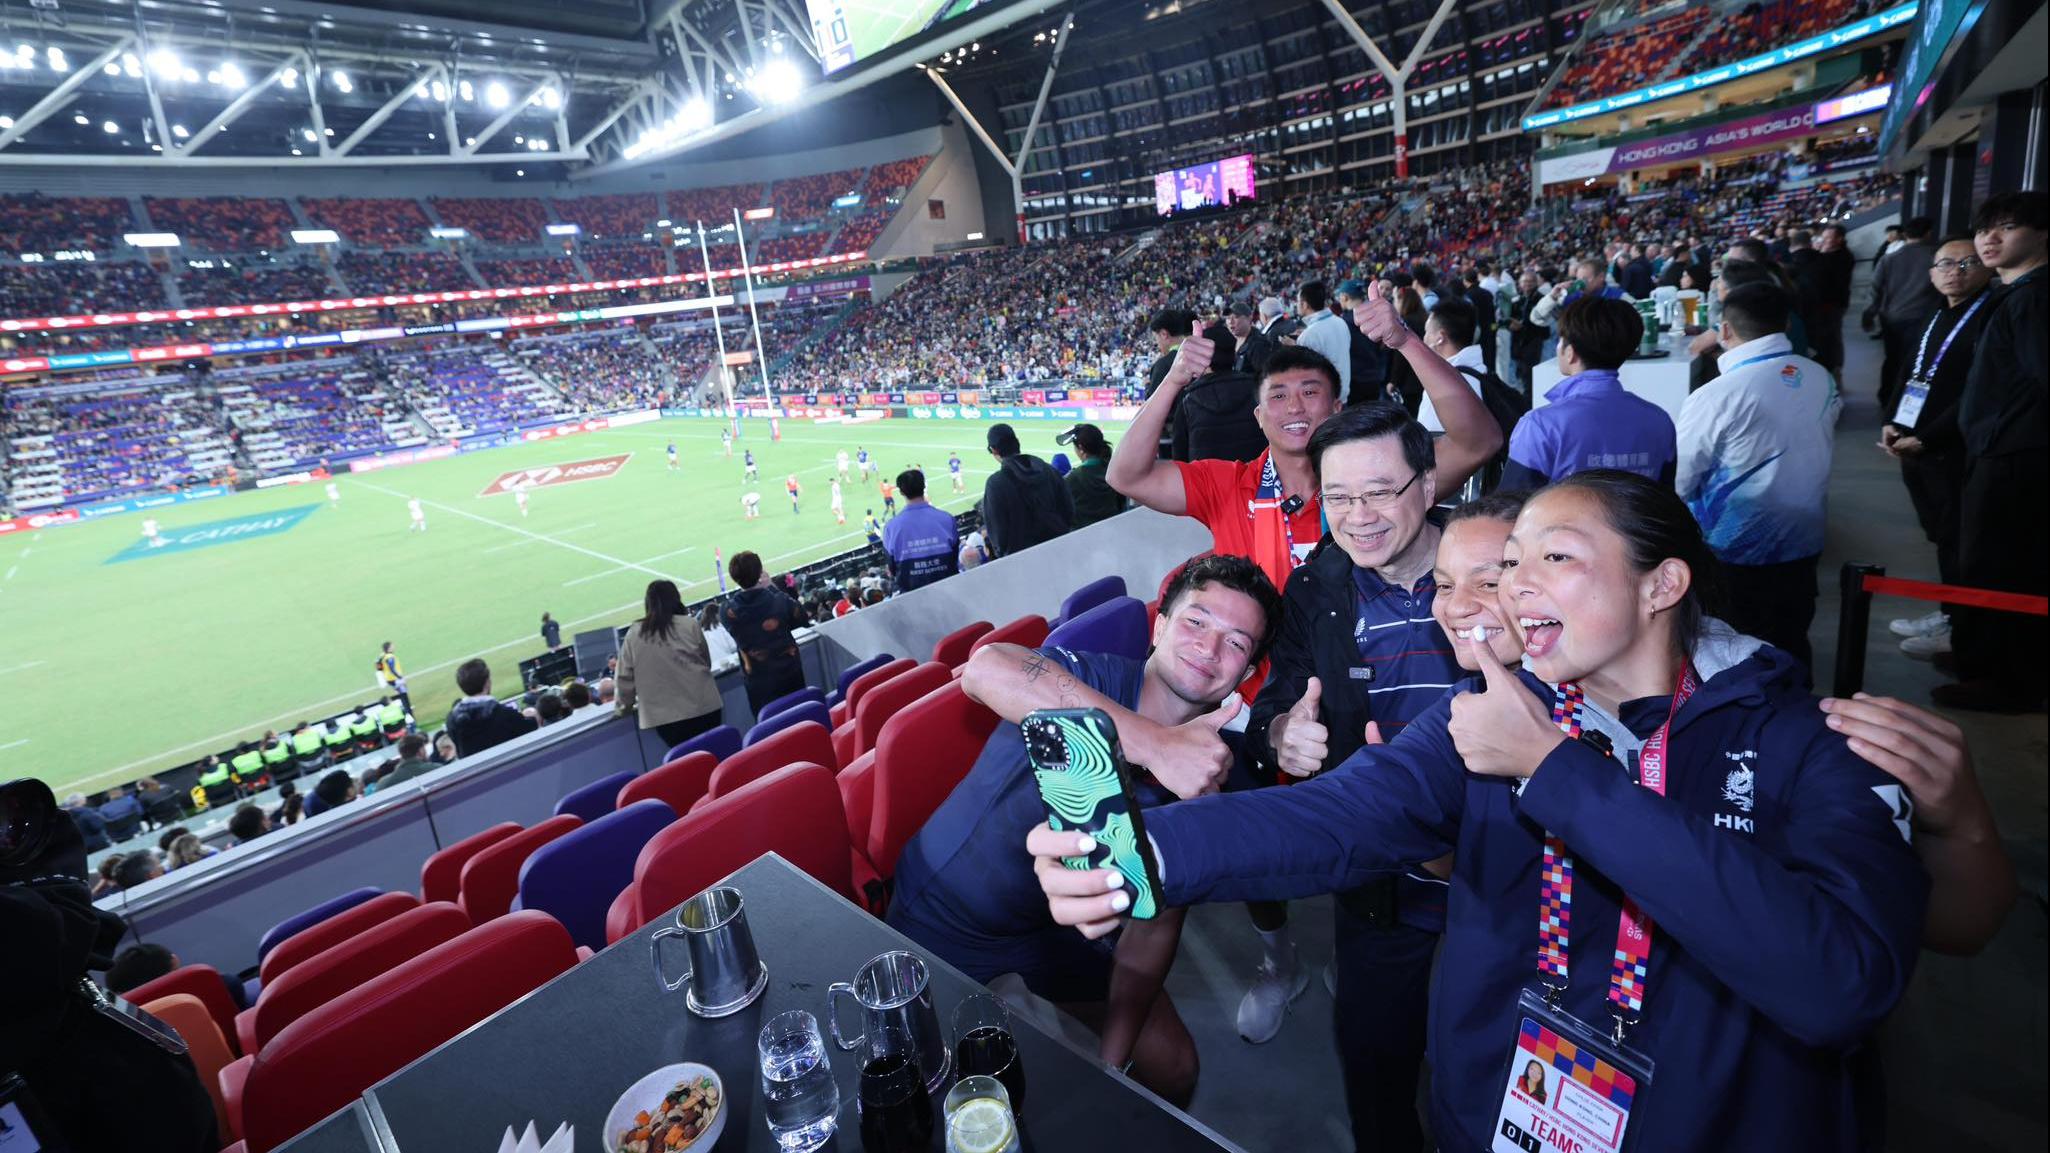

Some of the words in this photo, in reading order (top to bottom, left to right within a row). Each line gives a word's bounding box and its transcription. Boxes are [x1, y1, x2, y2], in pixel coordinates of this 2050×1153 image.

[1618, 147, 1658, 163] HONG
[1658, 138, 1698, 157] KONG
[1704, 127, 1749, 147] ASIA'S
[1751, 116, 1801, 137] WORLD
[562, 461, 618, 478] HSBC
[178, 514, 298, 543] CATHAY
[1644, 752, 1661, 788] HSBC
[1530, 1113, 1584, 1153] TEAMS
